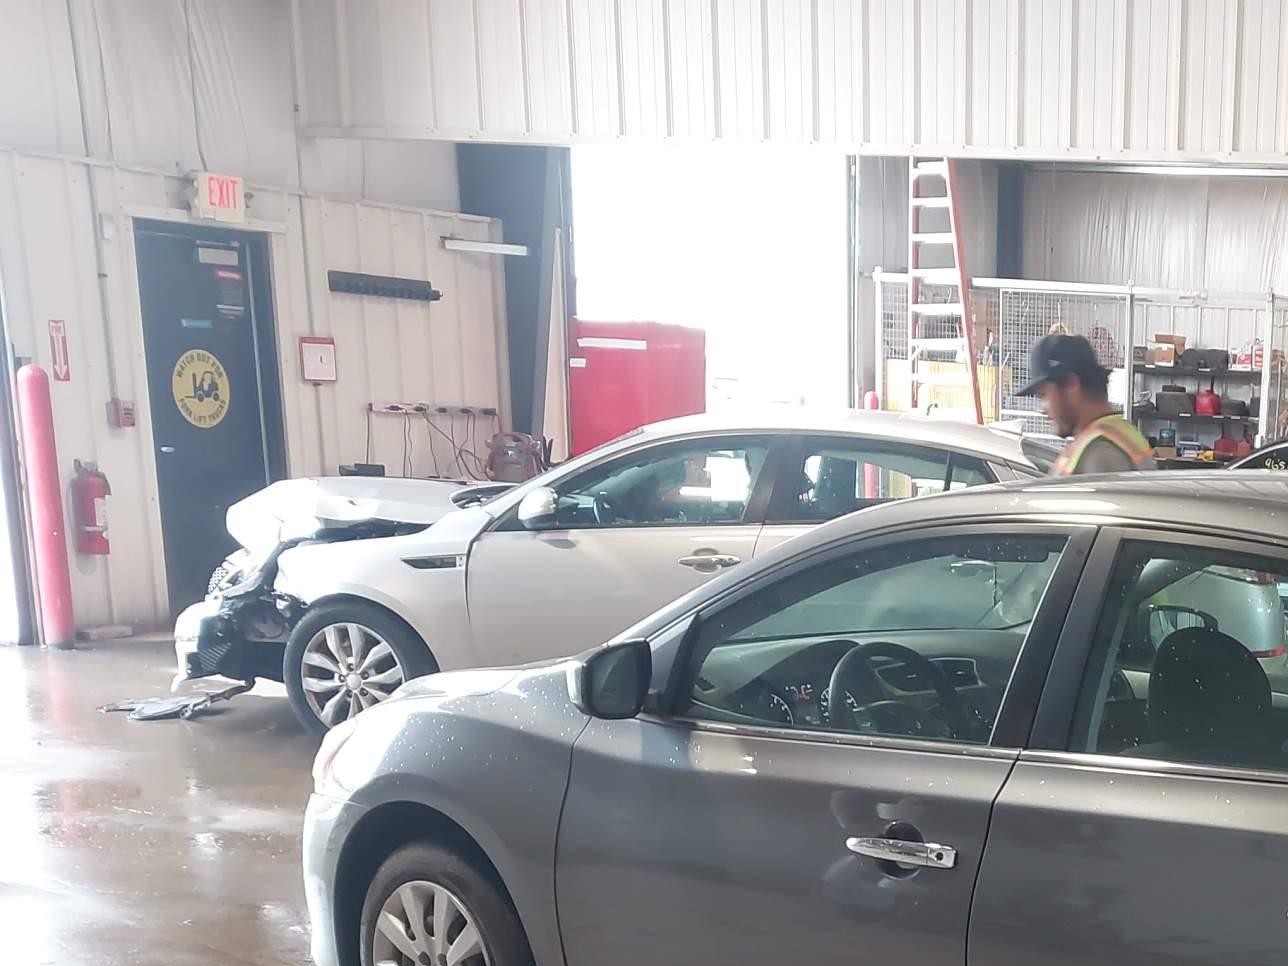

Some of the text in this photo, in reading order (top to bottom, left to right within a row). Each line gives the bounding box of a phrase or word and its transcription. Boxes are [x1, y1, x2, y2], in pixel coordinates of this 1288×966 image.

[208, 176, 238, 209] EXIT
[176, 353, 195, 378] WATCH
[196, 353, 209, 364] OUT
